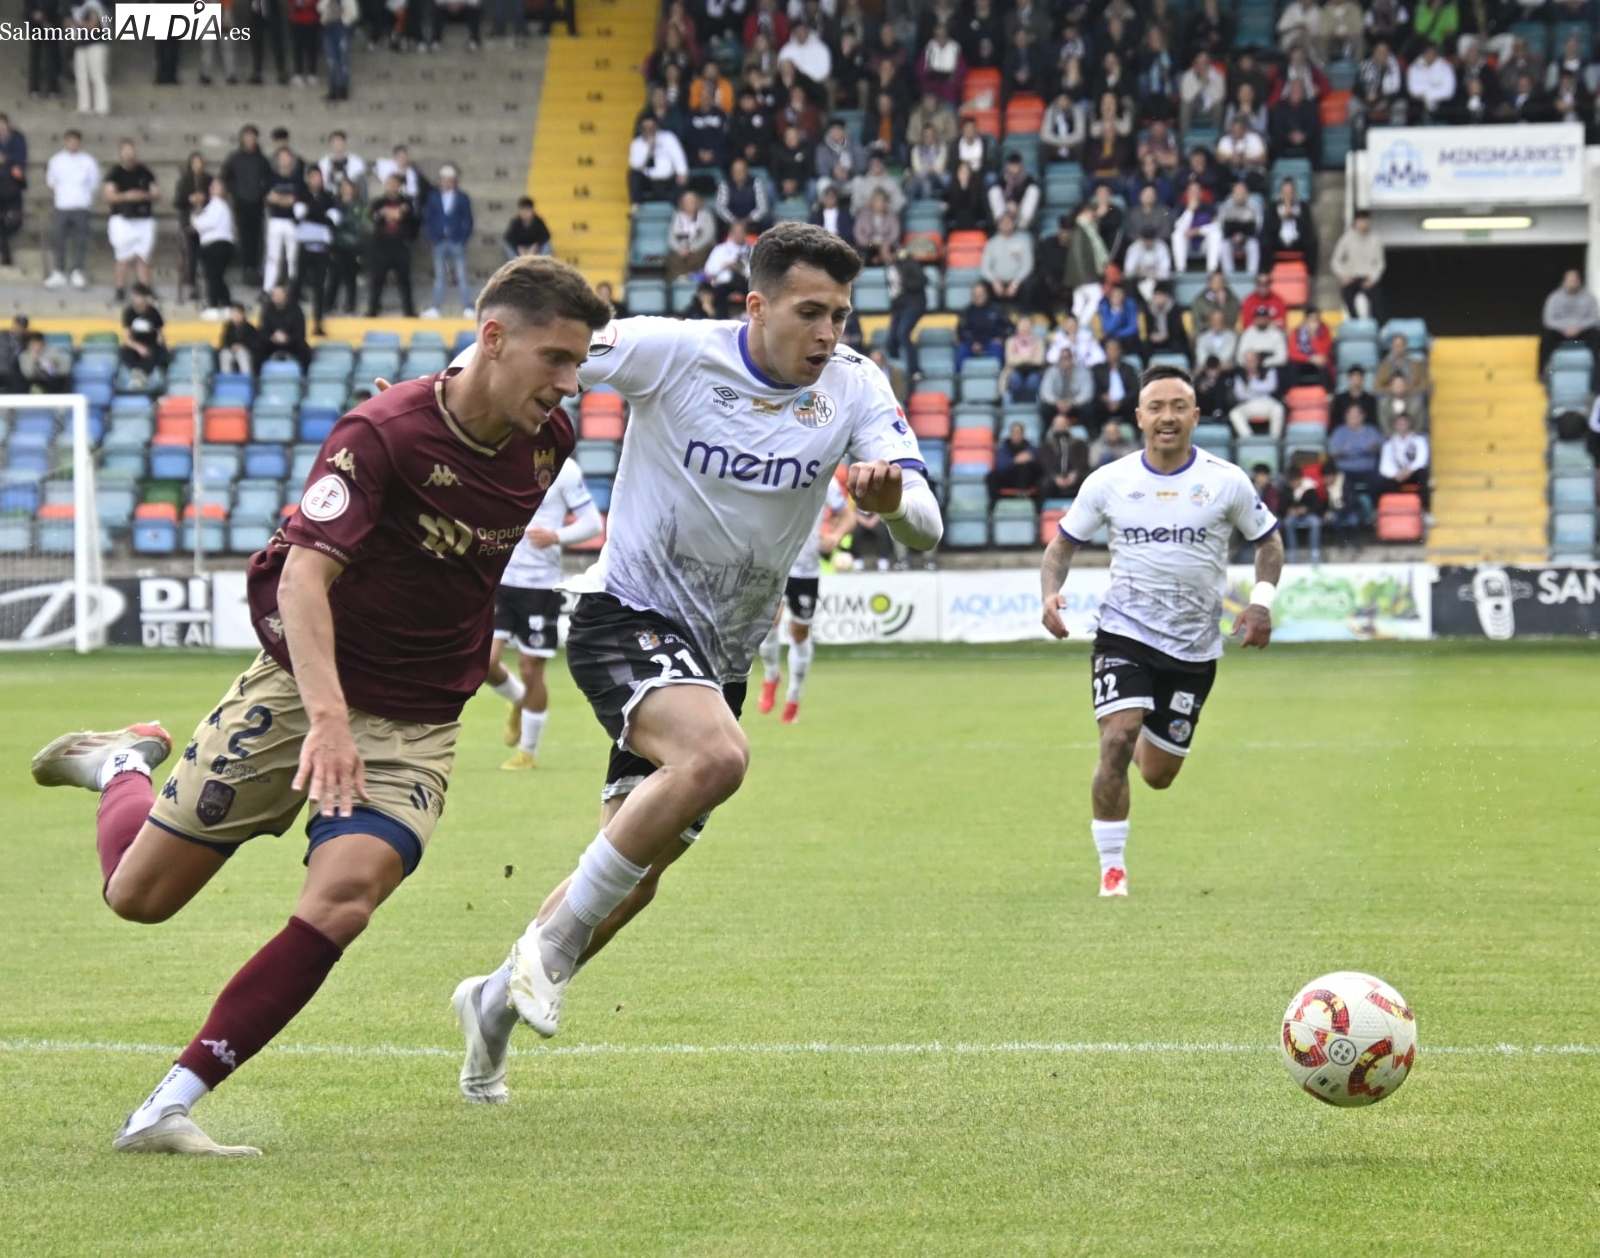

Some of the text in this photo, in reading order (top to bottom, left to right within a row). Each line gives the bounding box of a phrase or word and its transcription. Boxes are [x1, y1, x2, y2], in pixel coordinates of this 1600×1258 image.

[683, 438, 821, 489] meins
[1123, 524, 1208, 545] meins
[650, 648, 705, 679] 21
[1093, 673, 1119, 706] 22
[228, 705, 273, 759] 2
